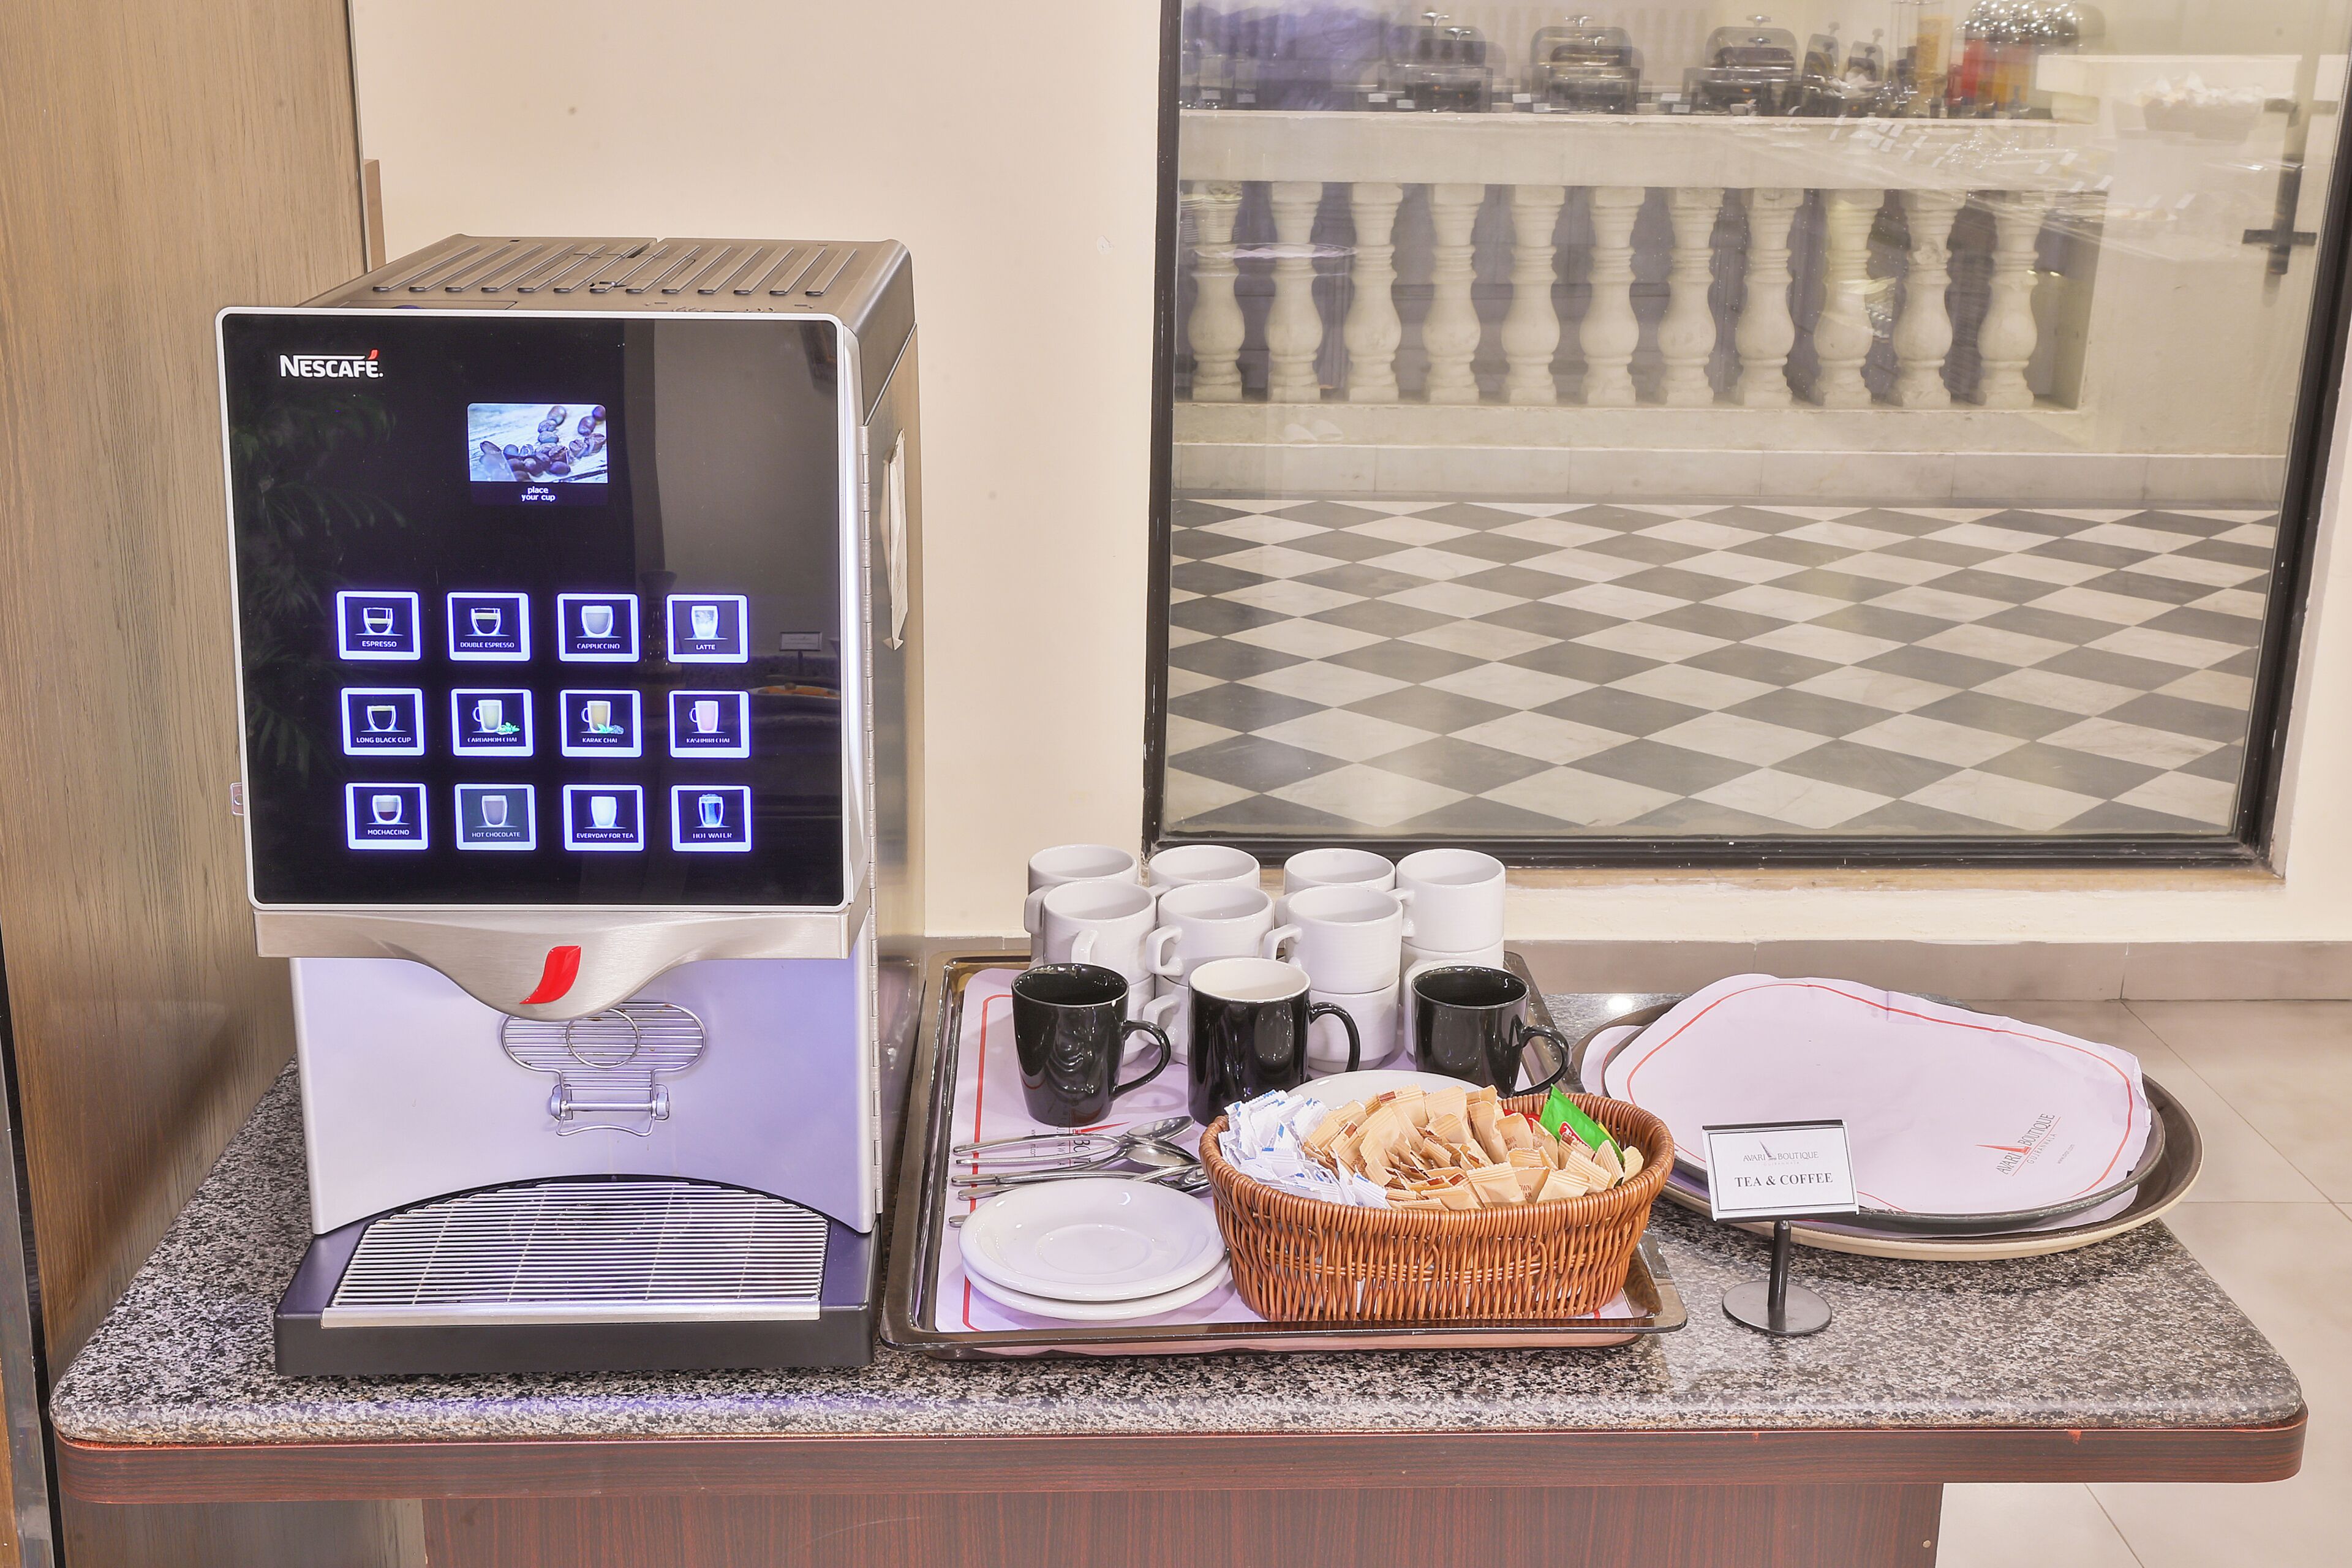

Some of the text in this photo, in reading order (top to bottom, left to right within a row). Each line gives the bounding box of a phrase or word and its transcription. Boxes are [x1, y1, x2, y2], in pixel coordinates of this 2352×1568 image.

[527, 486, 549, 495] place
[1996, 1113, 2056, 1175] AVARI BOUTIQUE
[1743, 1151, 1819, 1163] AVARI BOUTIQUE
[1735, 1172, 1833, 1188] TEA & COFFEE
